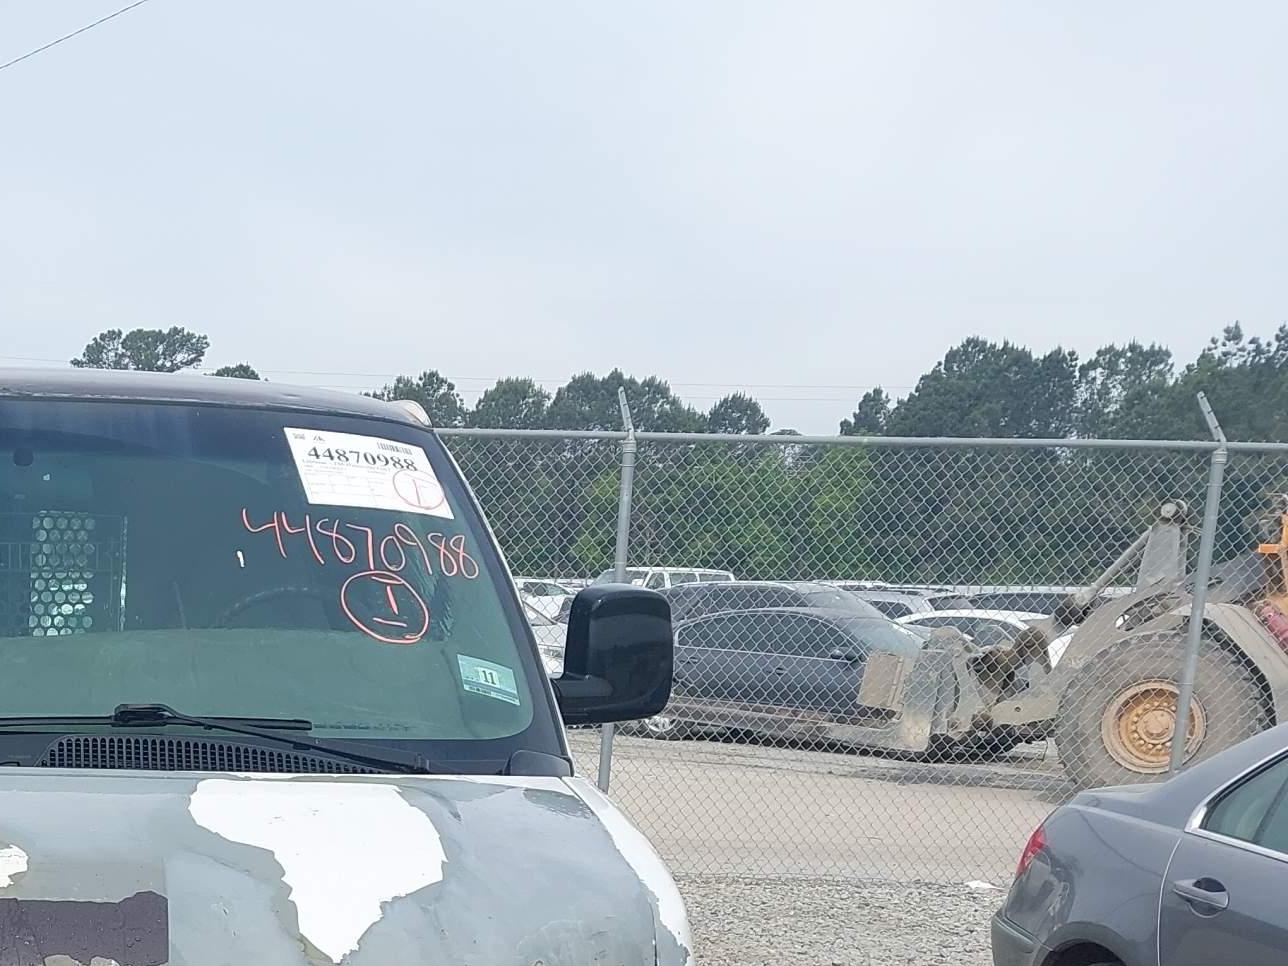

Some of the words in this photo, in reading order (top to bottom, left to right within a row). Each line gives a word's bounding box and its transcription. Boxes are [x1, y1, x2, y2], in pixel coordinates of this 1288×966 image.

[307, 446, 419, 472] 44870988
[242, 507, 479, 579] 44870988
[481, 670, 497, 686] 11
